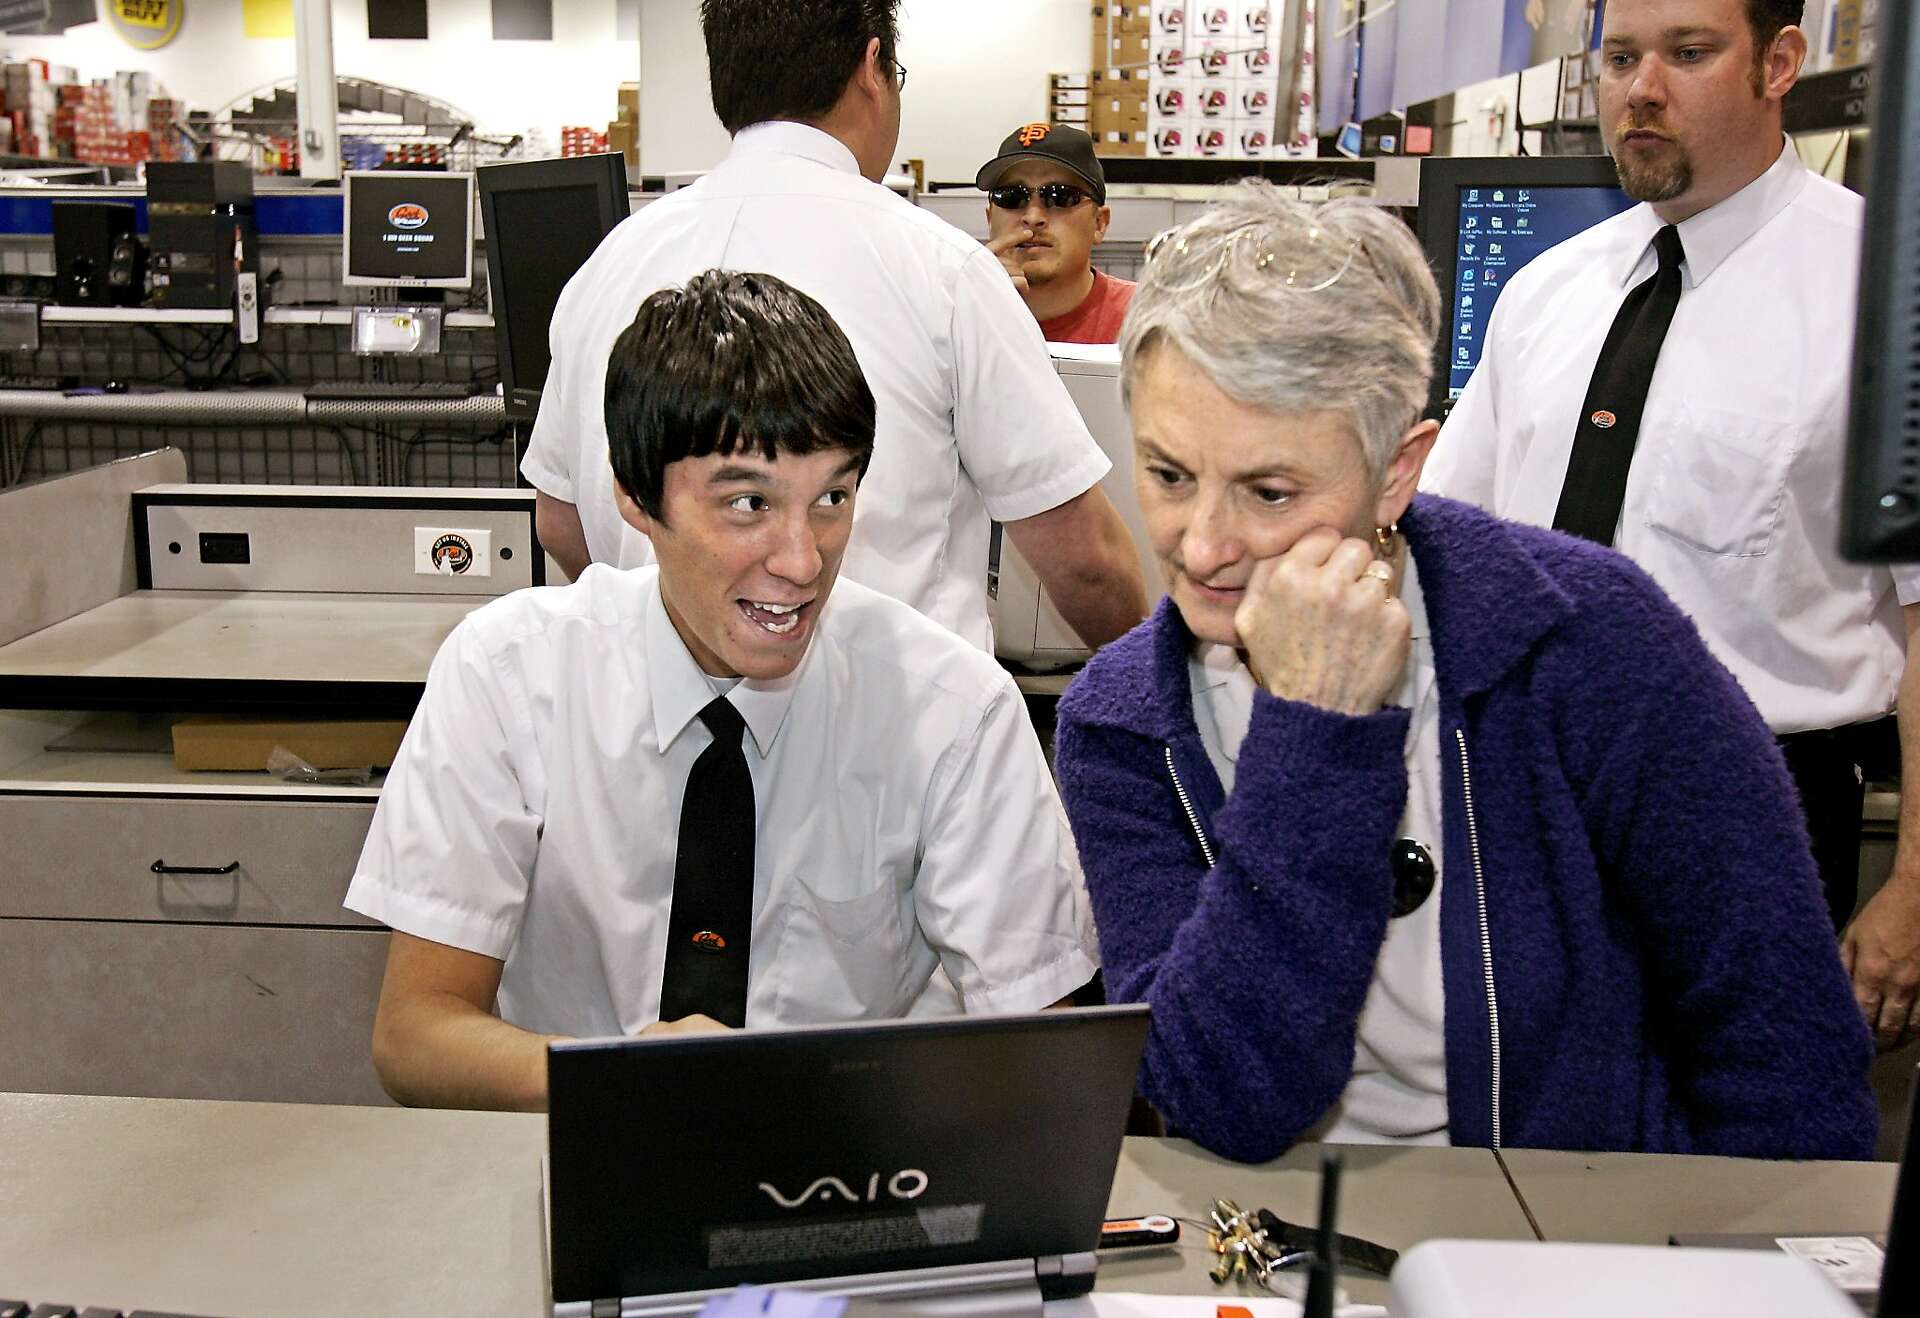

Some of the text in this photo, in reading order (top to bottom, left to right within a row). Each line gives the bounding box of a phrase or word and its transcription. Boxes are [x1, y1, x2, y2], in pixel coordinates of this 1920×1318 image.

[123, 8, 163, 21] BUY
[1018, 123, 1051, 148] SF
[758, 1168, 929, 1208] VAIO
